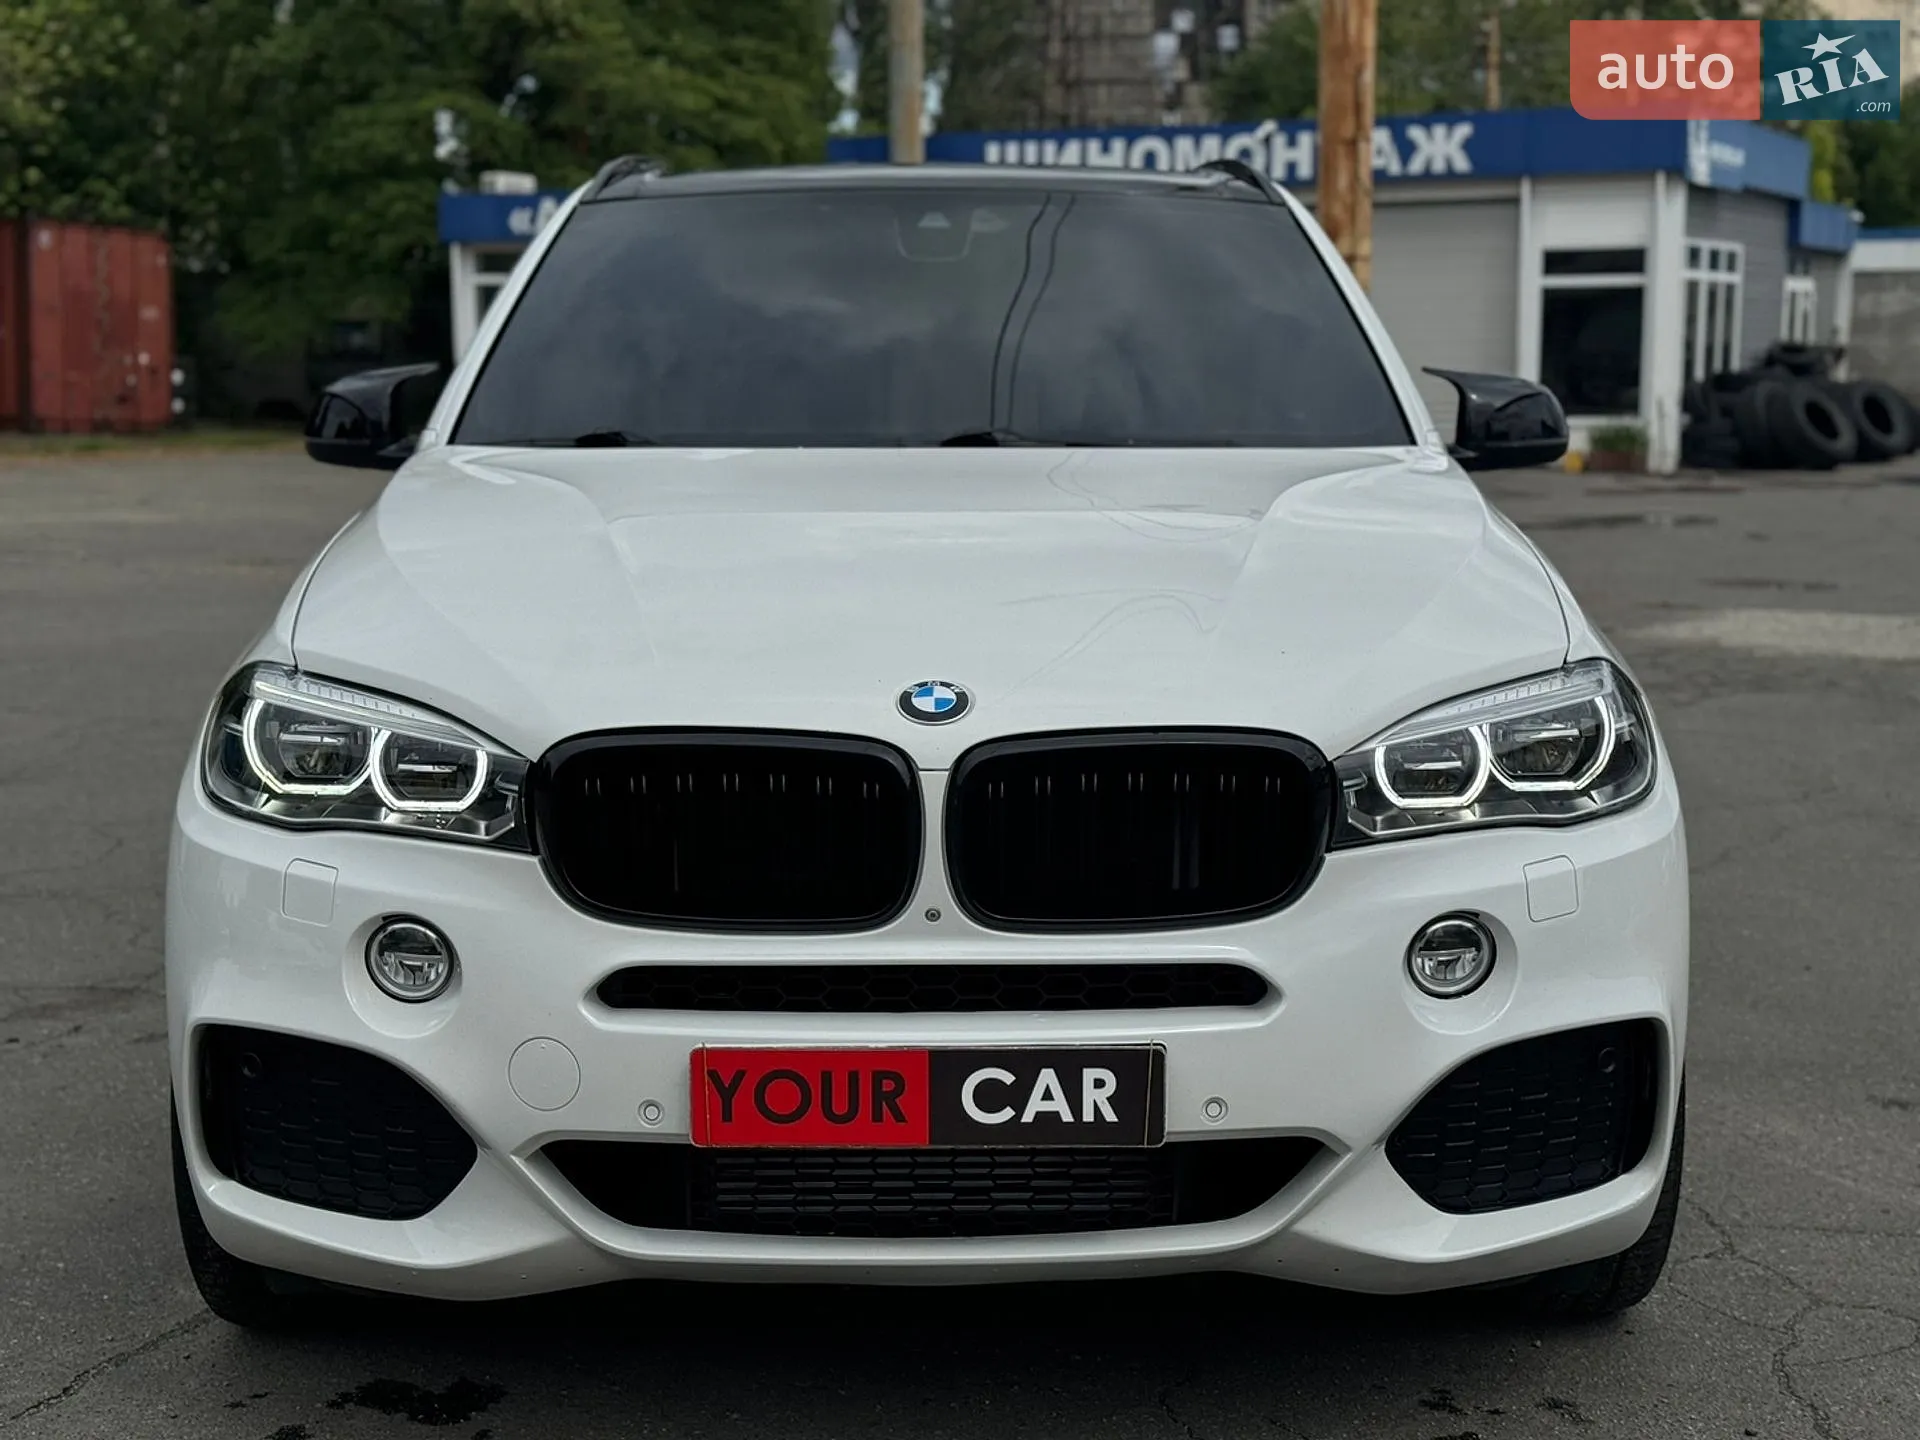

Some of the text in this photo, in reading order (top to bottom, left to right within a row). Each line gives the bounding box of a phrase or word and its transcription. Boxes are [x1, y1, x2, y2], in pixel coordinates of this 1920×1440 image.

[984, 121, 1474, 181] ШИНОМОНАЖ
[707, 1067, 1118, 1125] YOUR CAR
